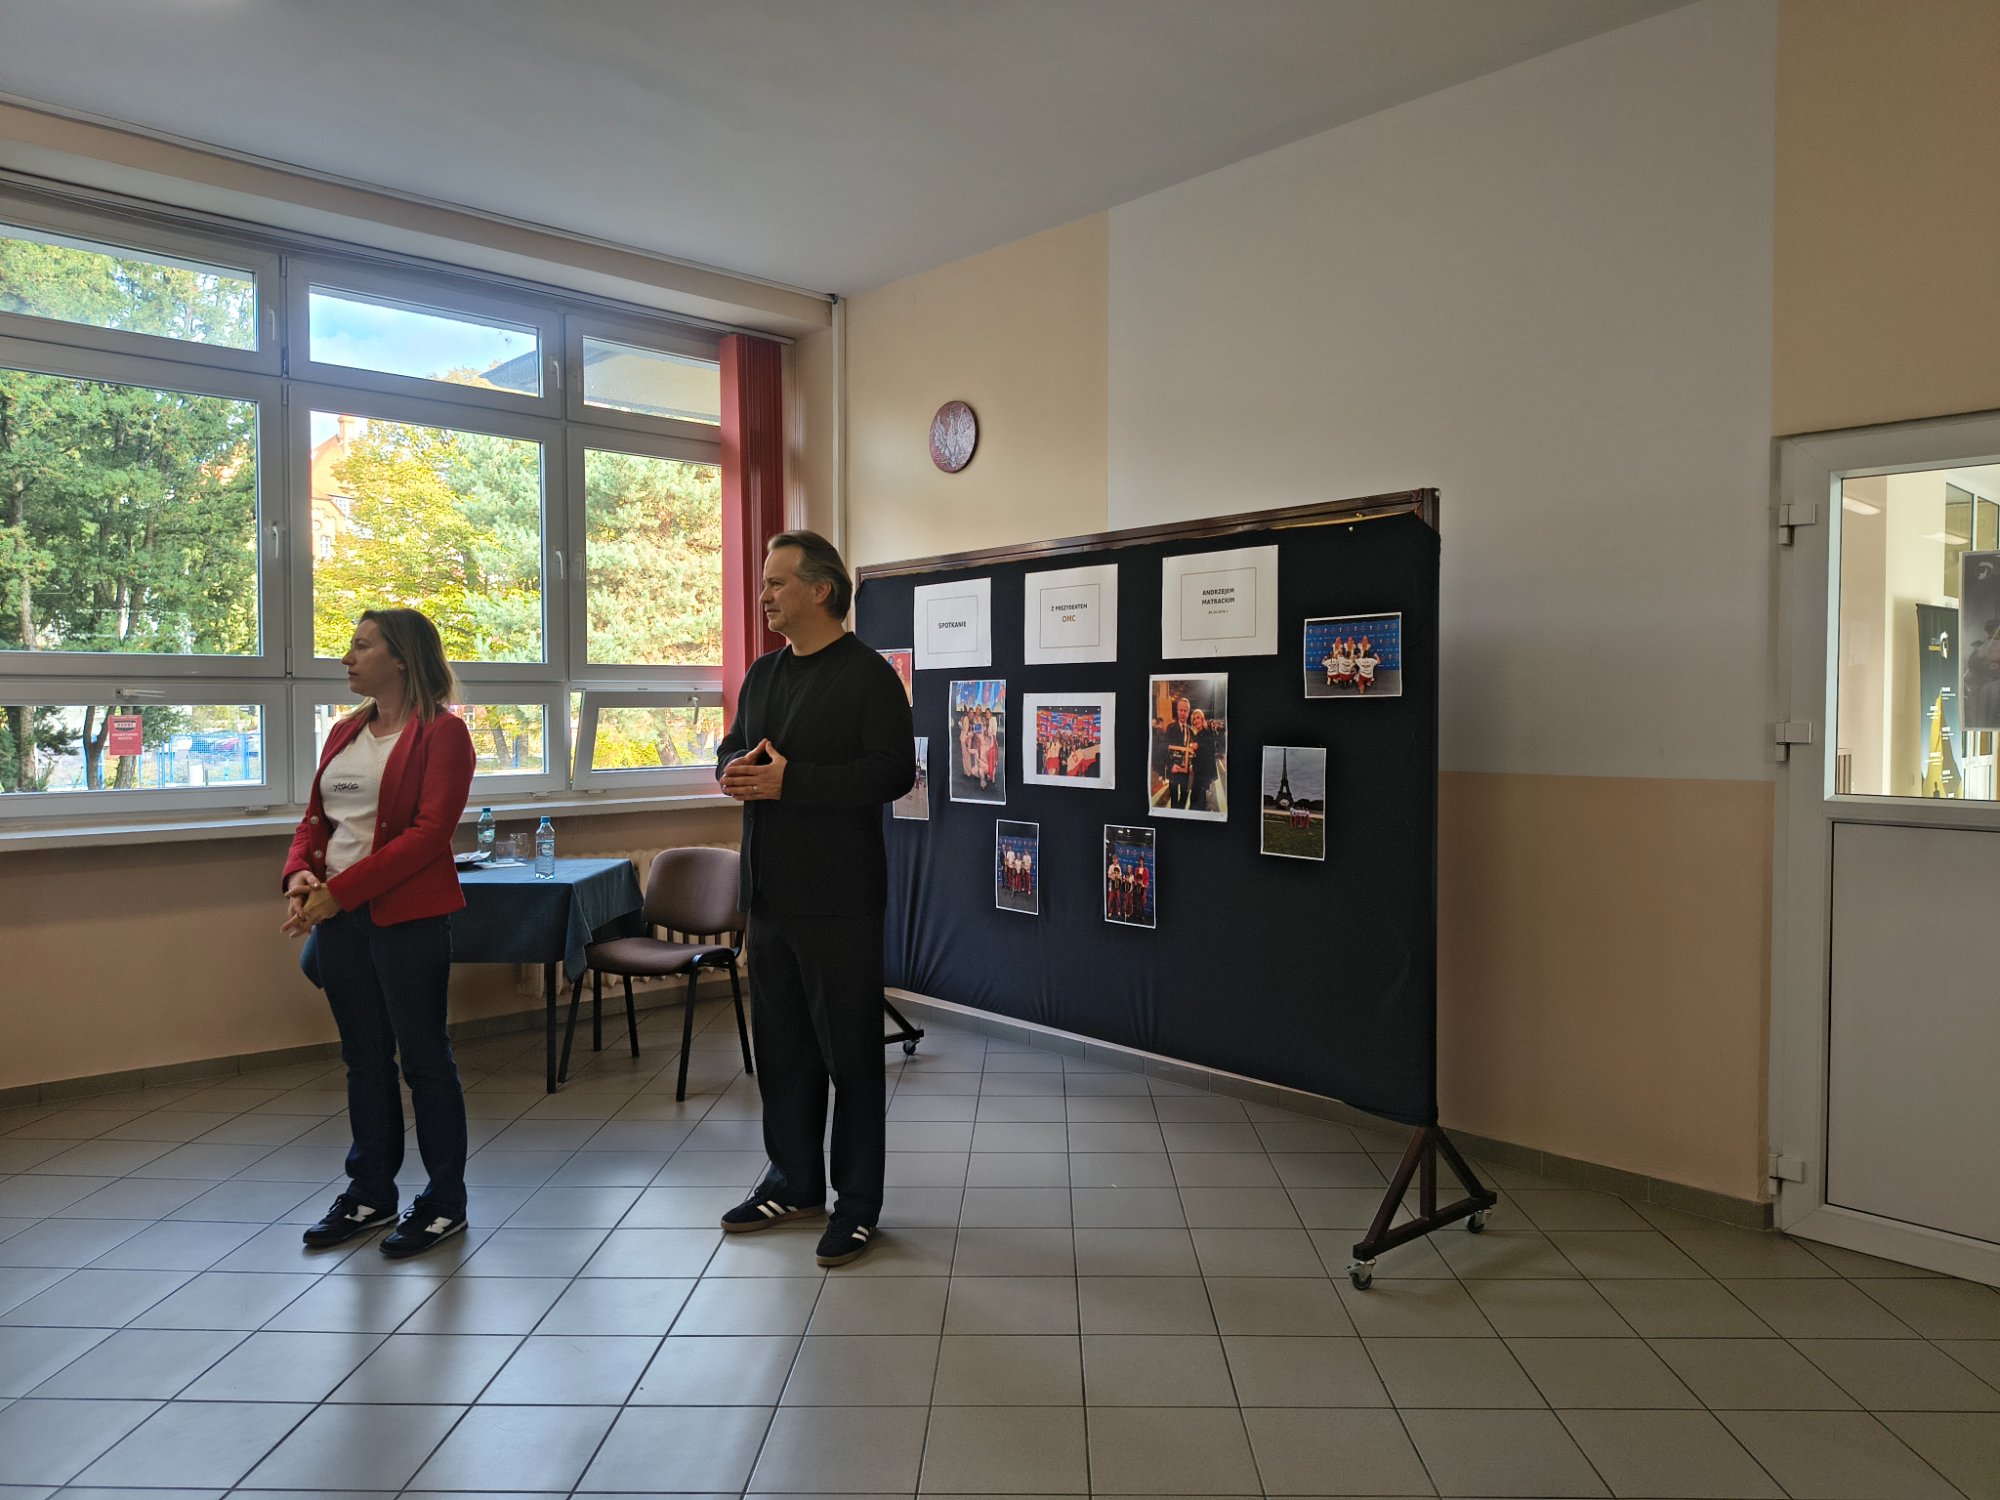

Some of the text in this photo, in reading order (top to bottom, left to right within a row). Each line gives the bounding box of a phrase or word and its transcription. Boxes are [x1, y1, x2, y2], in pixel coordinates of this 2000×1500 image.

[1202, 588, 1235, 596] ANDRZEJEM
[1201, 597, 1235, 605] MATRACKIM
[1055, 603, 1088, 611] PREZYDENTEM
[1062, 615, 1076, 623] OMC
[938, 621, 967, 629] SPOTKANIE
